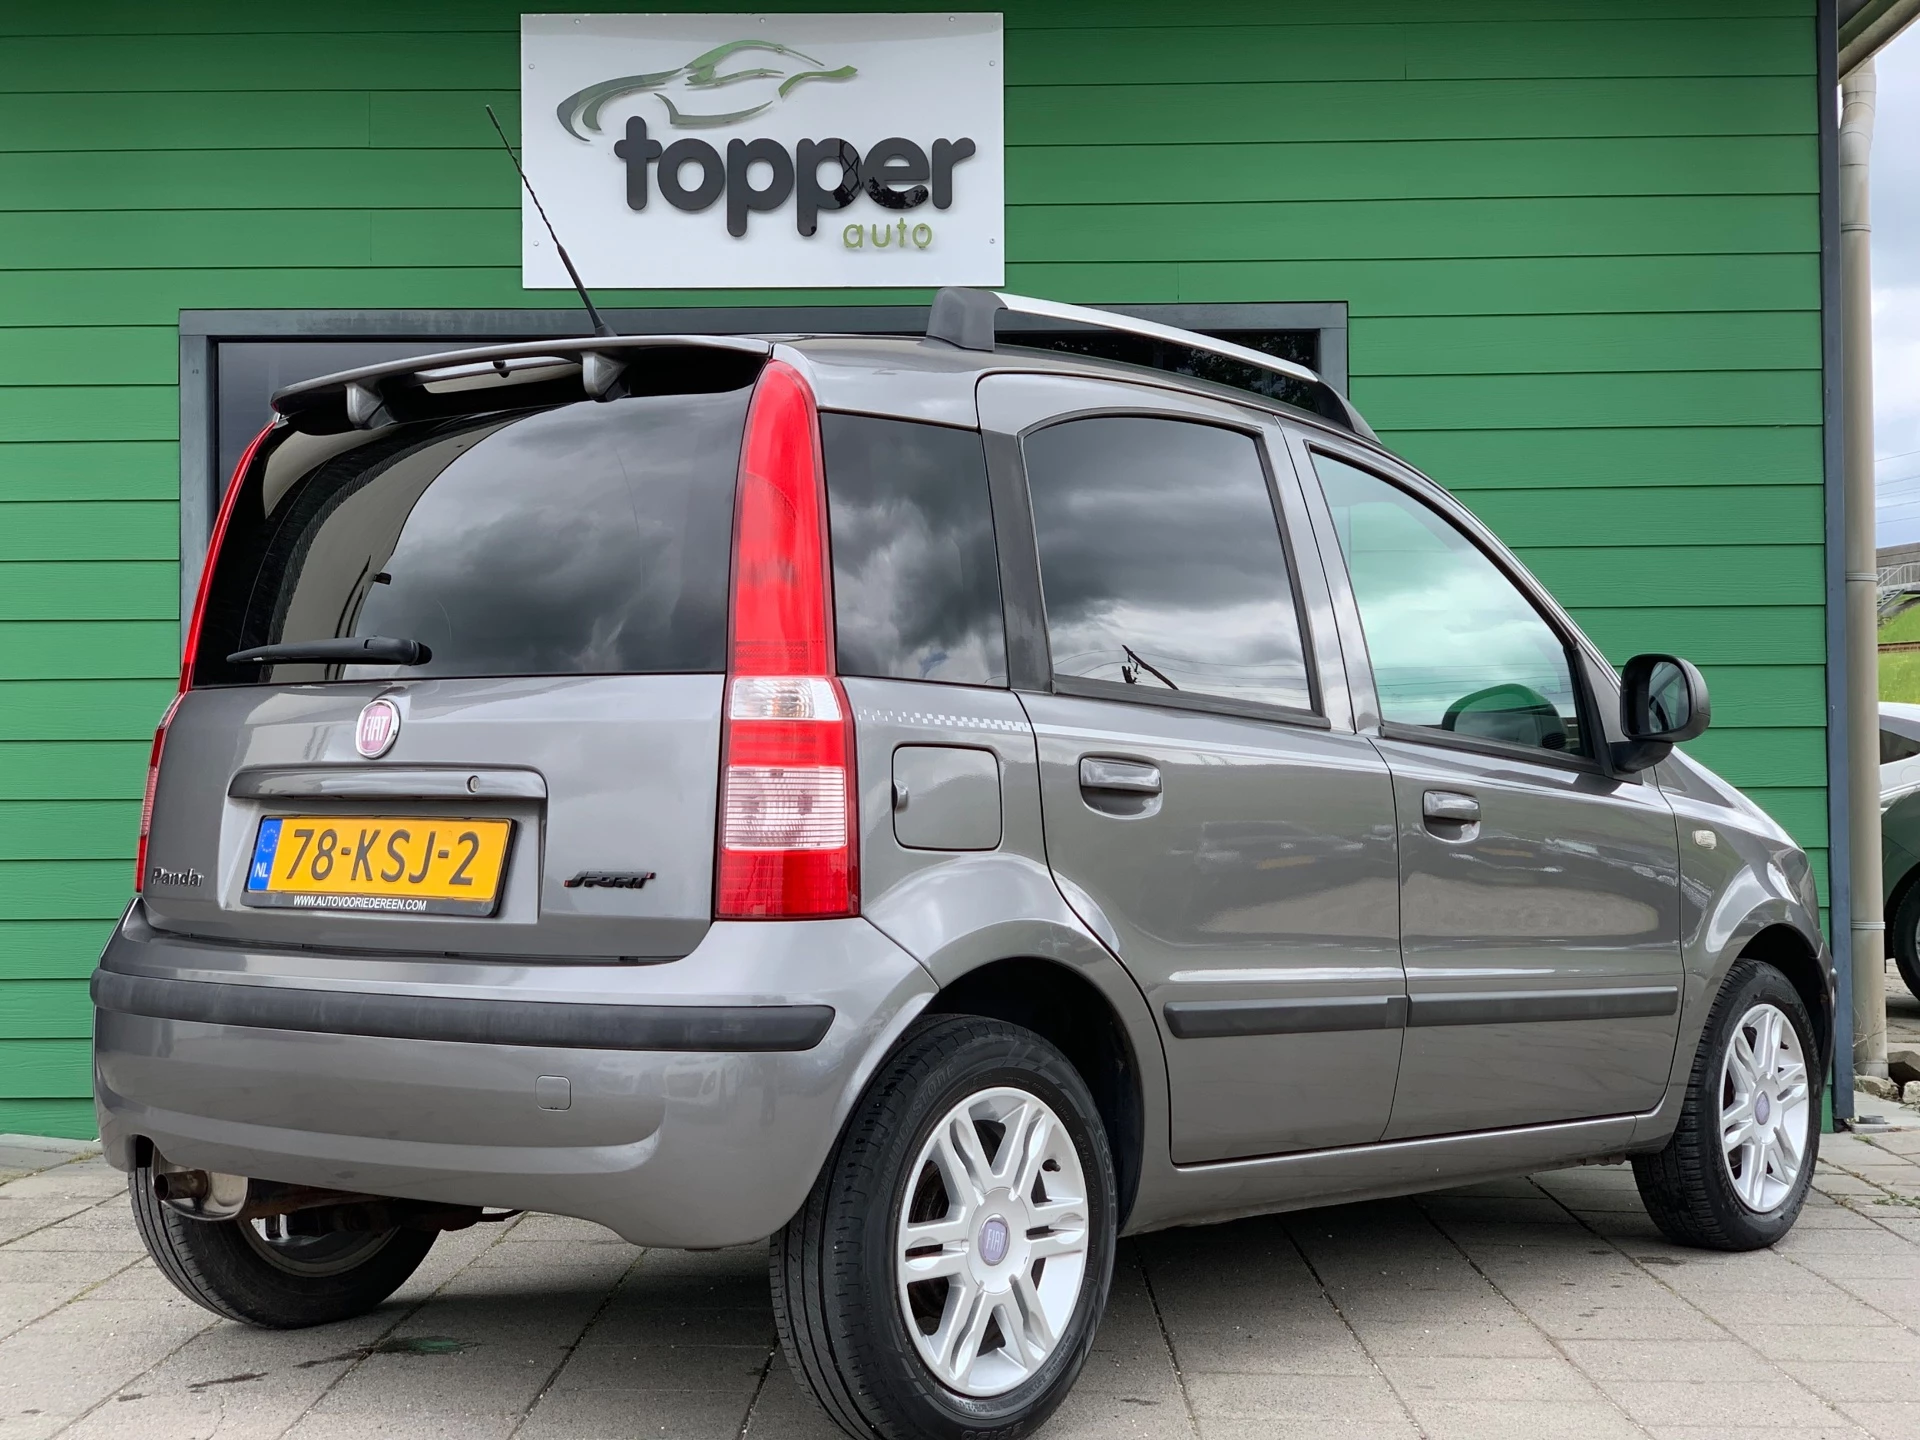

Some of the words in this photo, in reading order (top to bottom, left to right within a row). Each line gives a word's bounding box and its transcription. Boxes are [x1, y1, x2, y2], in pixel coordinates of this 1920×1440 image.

[614, 115, 976, 237] topper
[843, 218, 932, 249] auto
[363, 716, 389, 741] FIAT
[286, 828, 480, 886] 78-KSJ-2
[152, 867, 203, 887] Panda
[254, 862, 268, 877] NL
[293, 895, 427, 911] WWW.AUTOVOORIEDEREEN.COM
[986, 1229, 1005, 1252] FIAT
